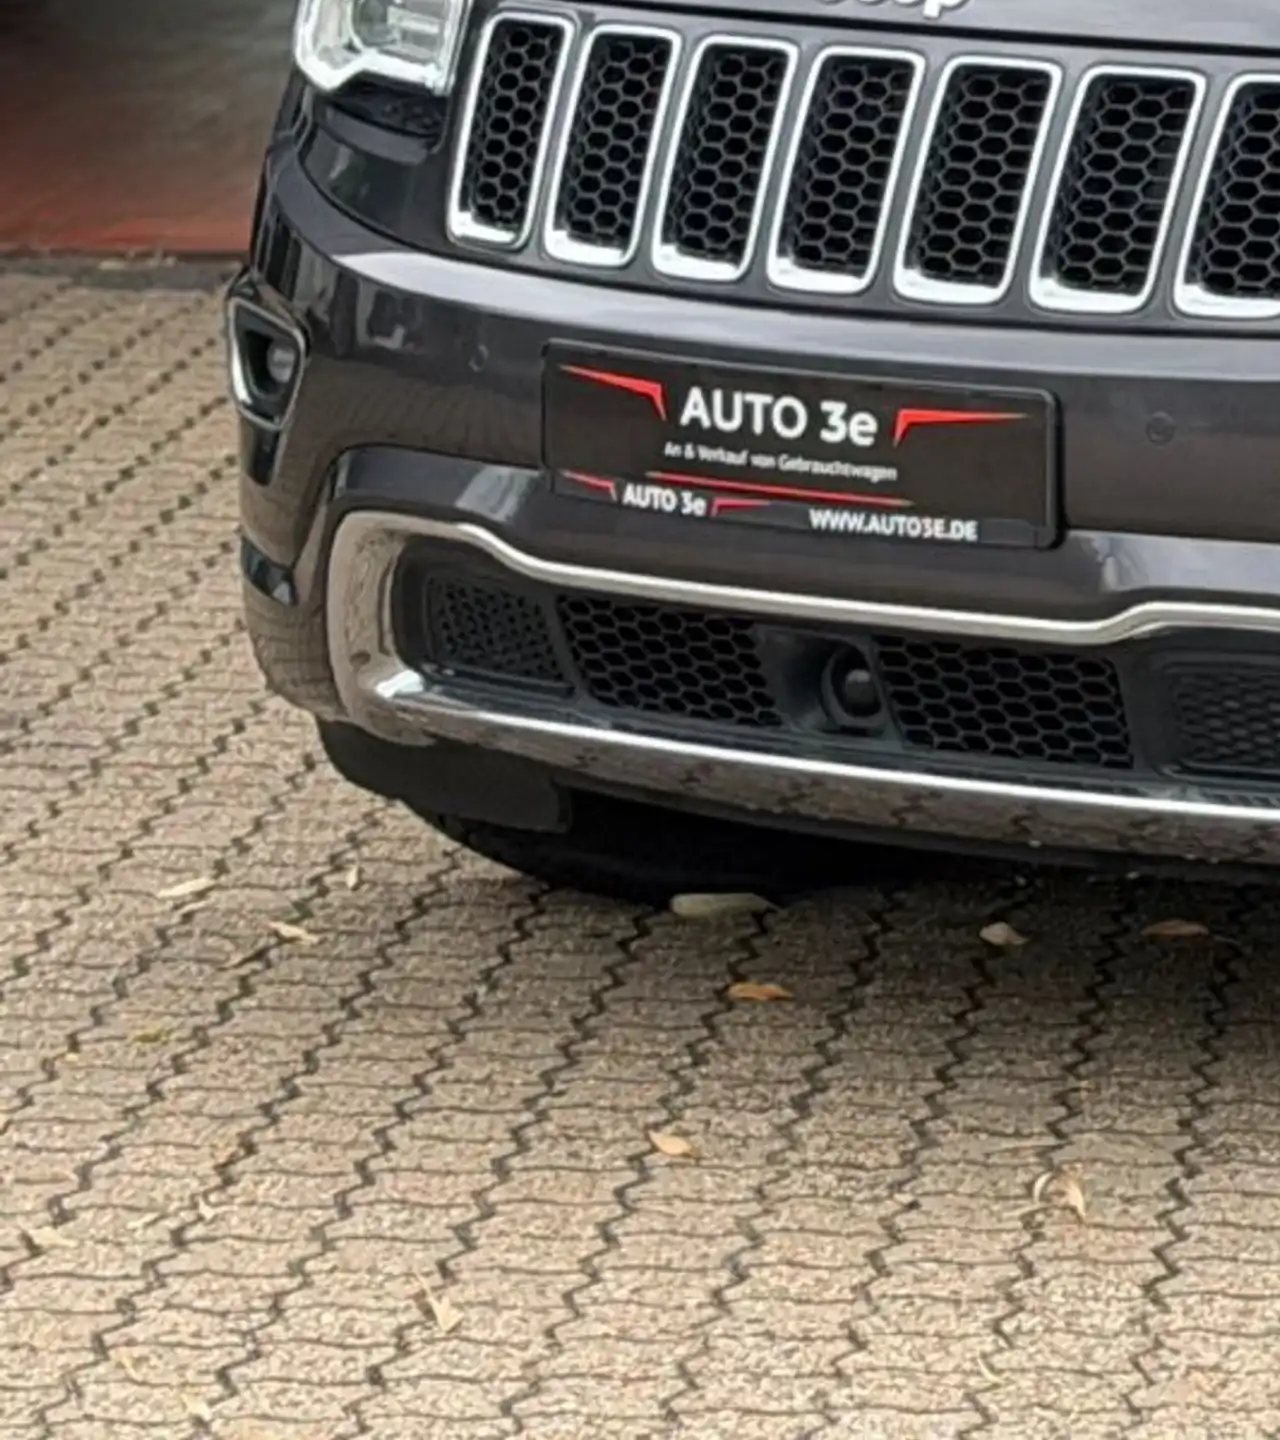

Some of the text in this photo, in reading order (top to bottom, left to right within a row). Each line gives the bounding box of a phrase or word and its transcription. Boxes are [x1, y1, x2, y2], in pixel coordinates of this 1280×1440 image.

[679, 386, 878, 447] AUTO 3e
[664, 441, 682, 457] An
[697, 444, 749, 466] Verkauf
[750, 454, 777, 468] von
[778, 454, 898, 483] Gebrauchtwagen
[622, 483, 707, 516] AUTO 3e
[809, 509, 978, 541] WWW.AUTO3E.DE
